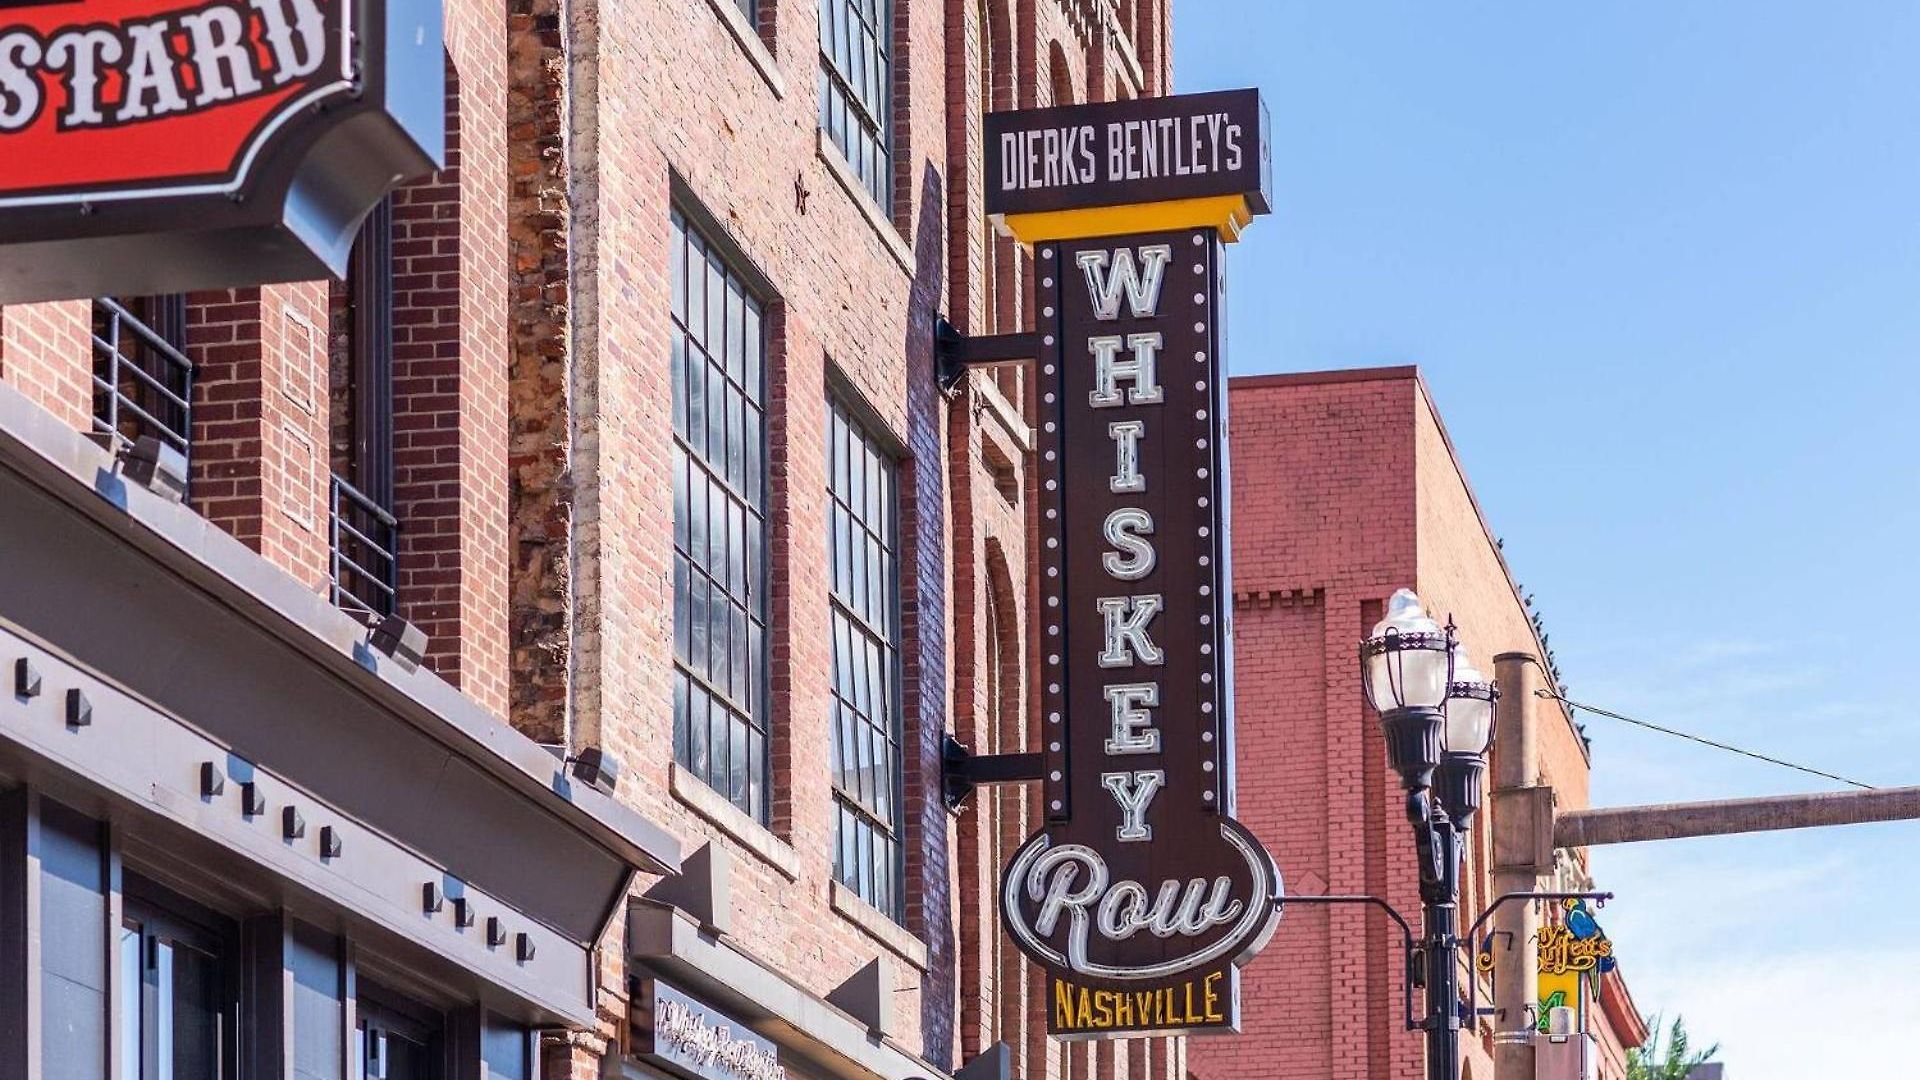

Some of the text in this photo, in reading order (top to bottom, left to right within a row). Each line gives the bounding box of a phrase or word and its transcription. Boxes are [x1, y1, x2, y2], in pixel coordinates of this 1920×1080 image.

[1001, 113, 1242, 191] DIERKS BENTLEY's
[1075, 244, 1171, 842] WHISKEY
[1027, 844, 1243, 971] Row
[1055, 971, 1224, 1030] NASHVILLE
